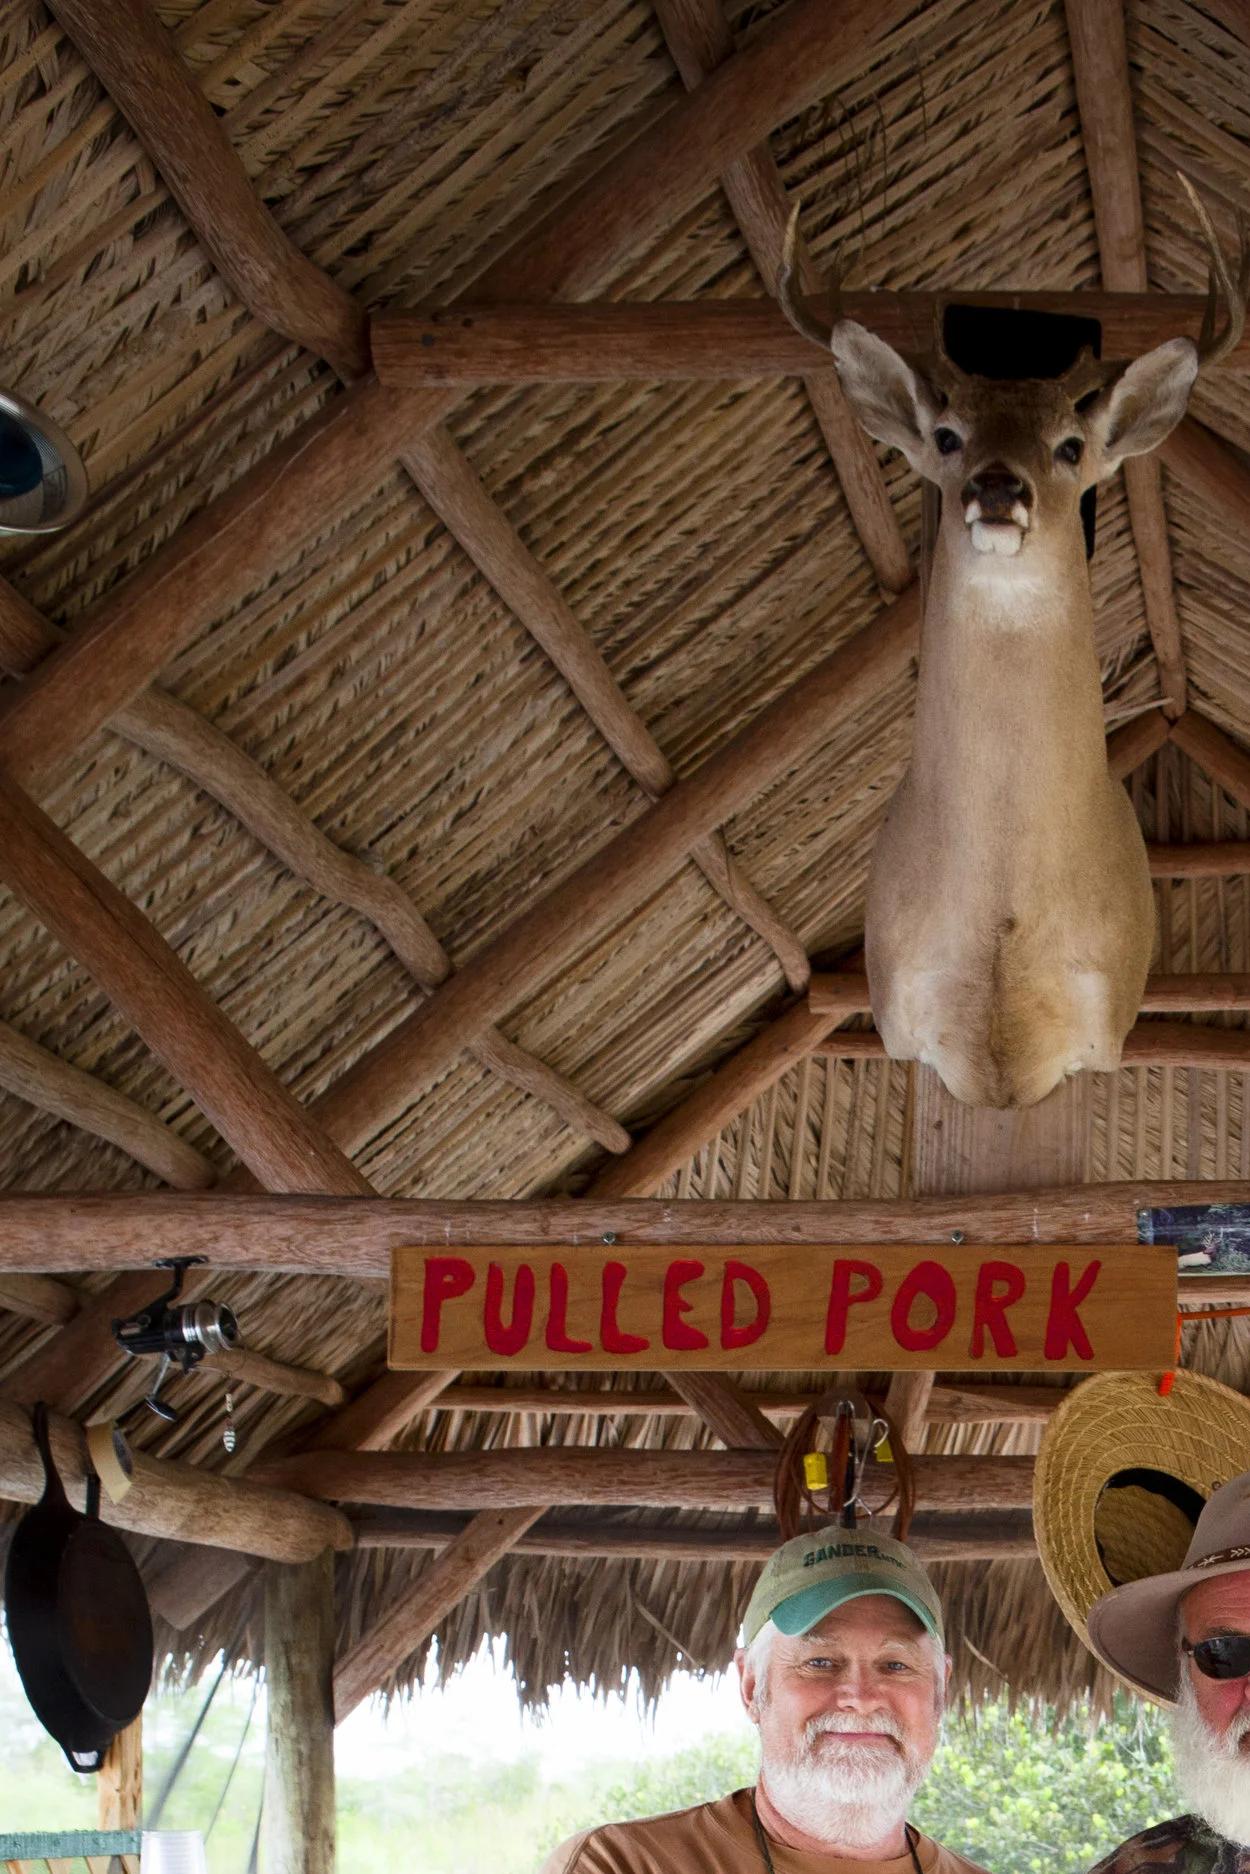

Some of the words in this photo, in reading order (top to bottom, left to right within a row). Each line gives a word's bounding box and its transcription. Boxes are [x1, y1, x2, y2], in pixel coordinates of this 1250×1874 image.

[421, 1256, 772, 1357] PULLED
[823, 1258, 1103, 1361] PORK
[803, 1543, 879, 1567] GANDER
